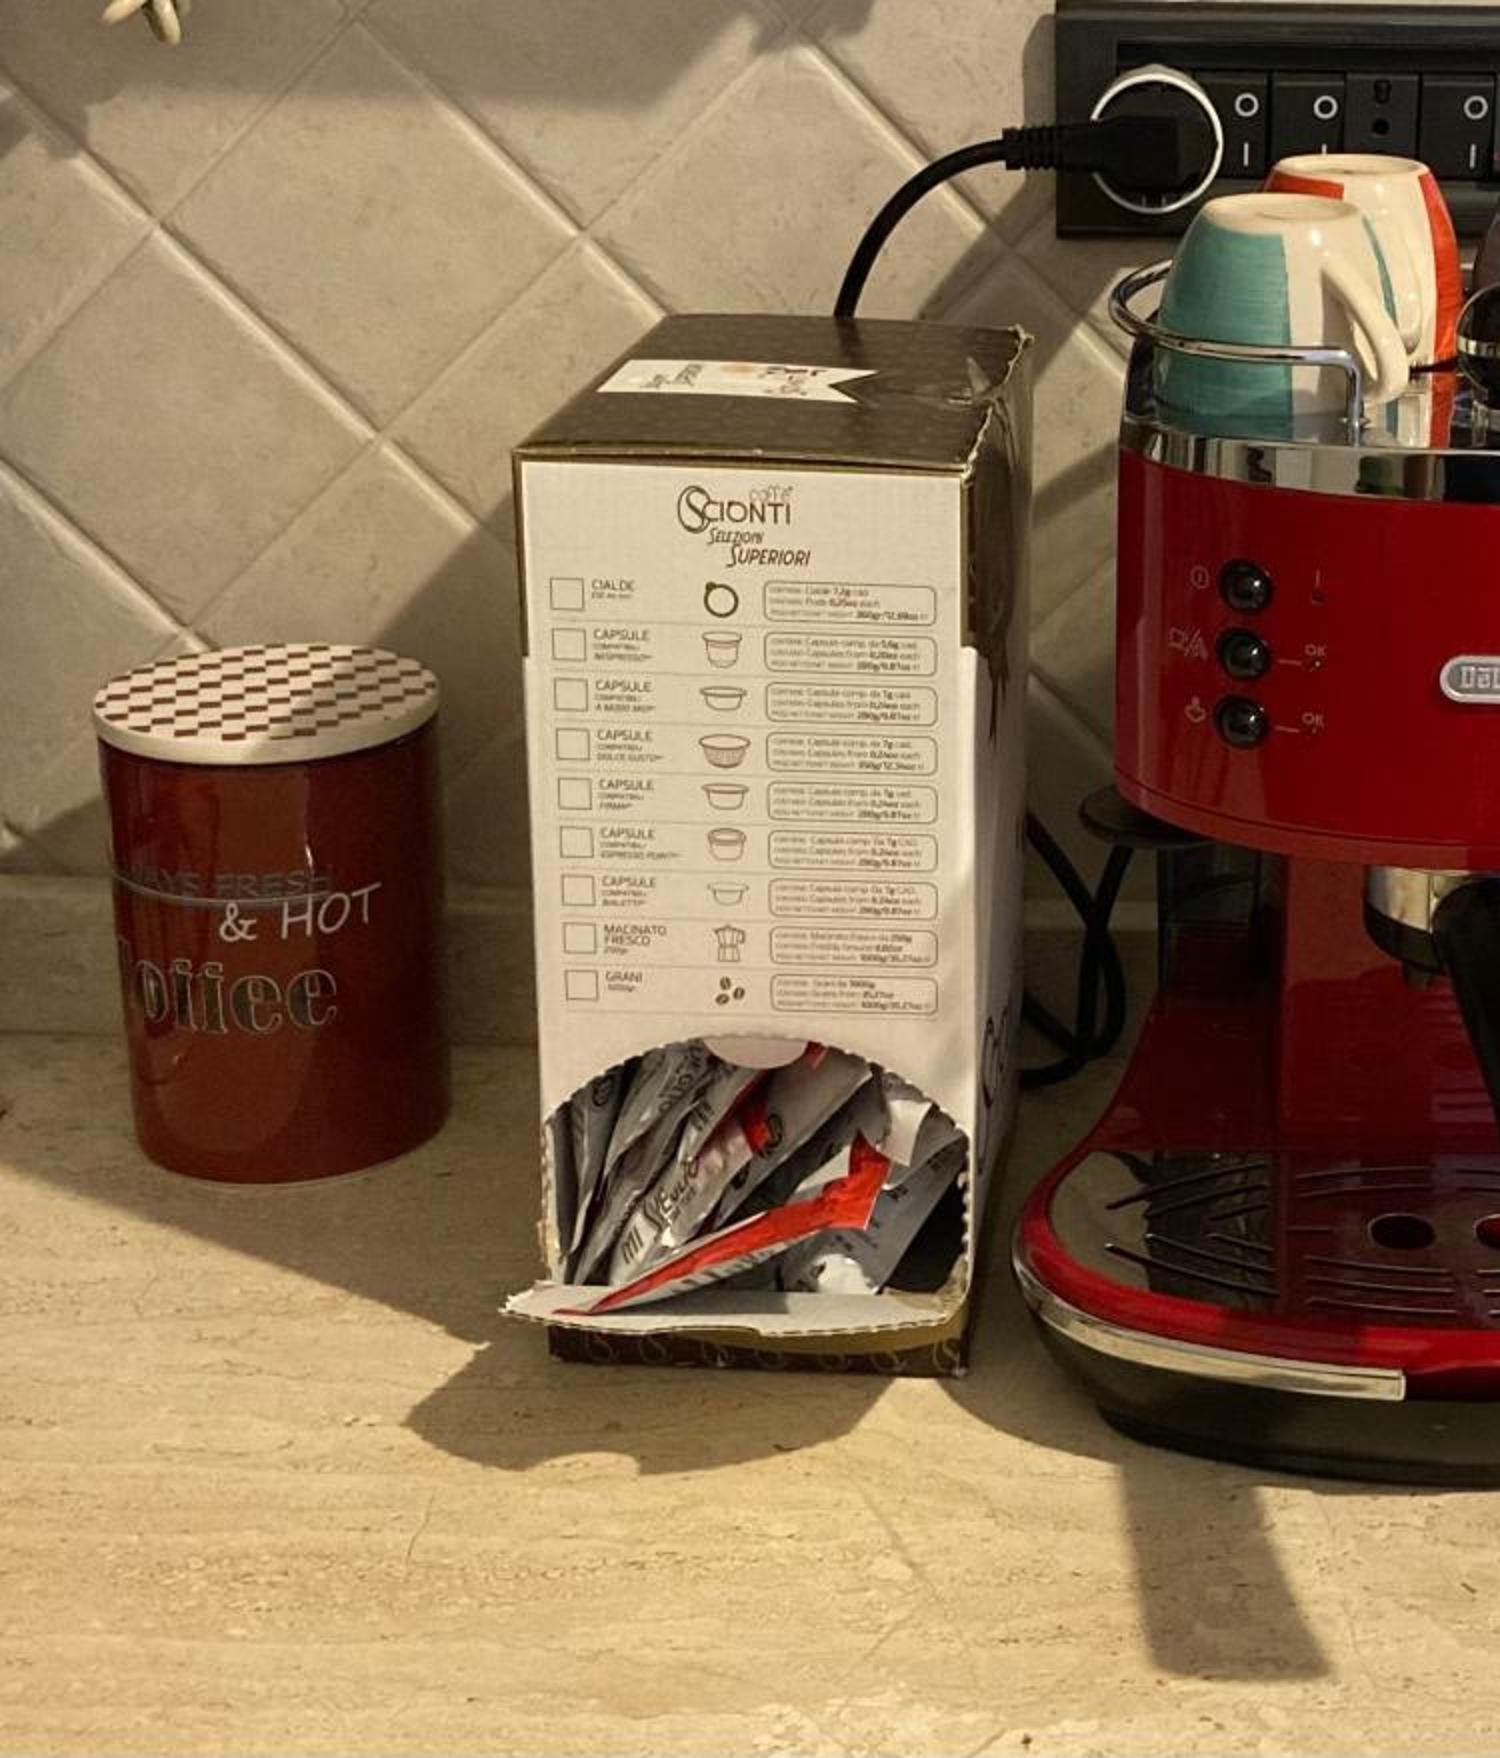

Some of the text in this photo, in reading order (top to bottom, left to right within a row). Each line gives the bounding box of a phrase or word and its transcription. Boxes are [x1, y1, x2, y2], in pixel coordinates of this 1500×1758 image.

[726, 543, 811, 568] SUPERIORI
[593, 628, 650, 641] CAPSULE
[1304, 644, 1326, 656] OK
[595, 680, 652, 692] CAPSULE
[1302, 712, 1324, 725] OK
[597, 729, 653, 742] CAPSULE
[599, 779, 655, 791] CAPSULE
[600, 828, 655, 840] CAPSULE
[602, 875, 656, 888] CAPSULE
[219, 882, 382, 943] & HOT
[604, 924, 667, 936] MACINATO
[604, 935, 651, 946] FRESCO
[606, 971, 643, 982] GRANI
